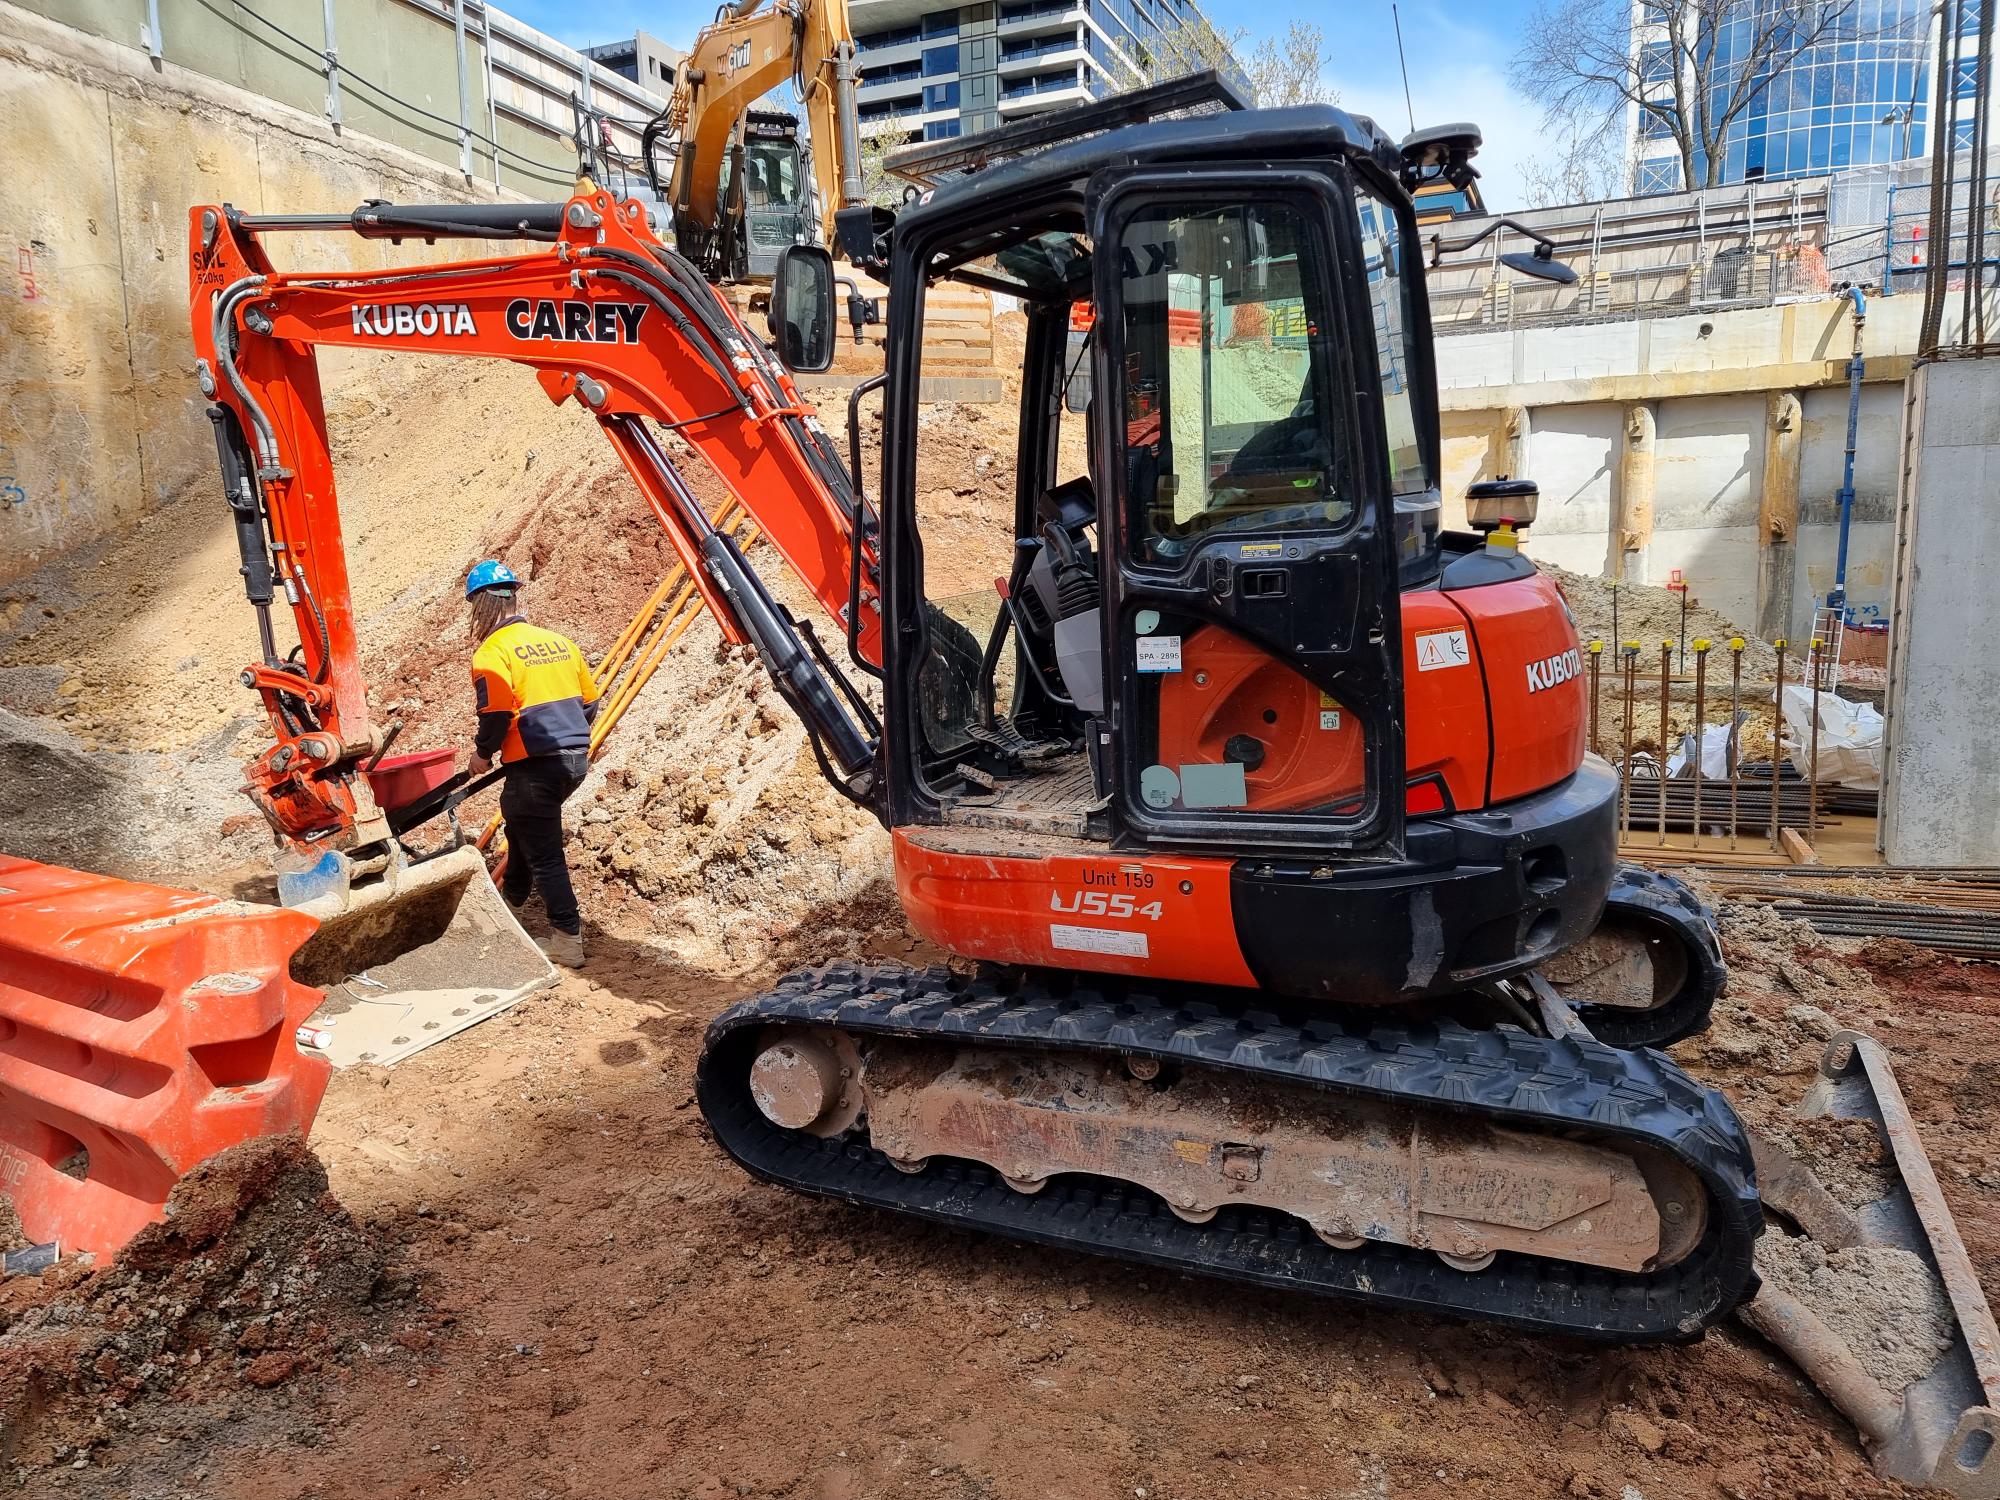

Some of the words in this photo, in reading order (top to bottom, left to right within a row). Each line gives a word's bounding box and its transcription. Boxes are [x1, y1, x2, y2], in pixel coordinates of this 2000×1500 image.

[192, 251, 226, 271] SWL
[197, 272, 224, 285] 520kg
[351, 304, 477, 336] KUBOTA
[505, 298, 649, 344] CAREY
[1138, 652, 1154, 660] SPA
[1160, 652, 1180, 660] 2895
[1526, 647, 1583, 694] KUBOTA
[1082, 868, 1117, 886] Unit
[1123, 872, 1154, 888] 159
